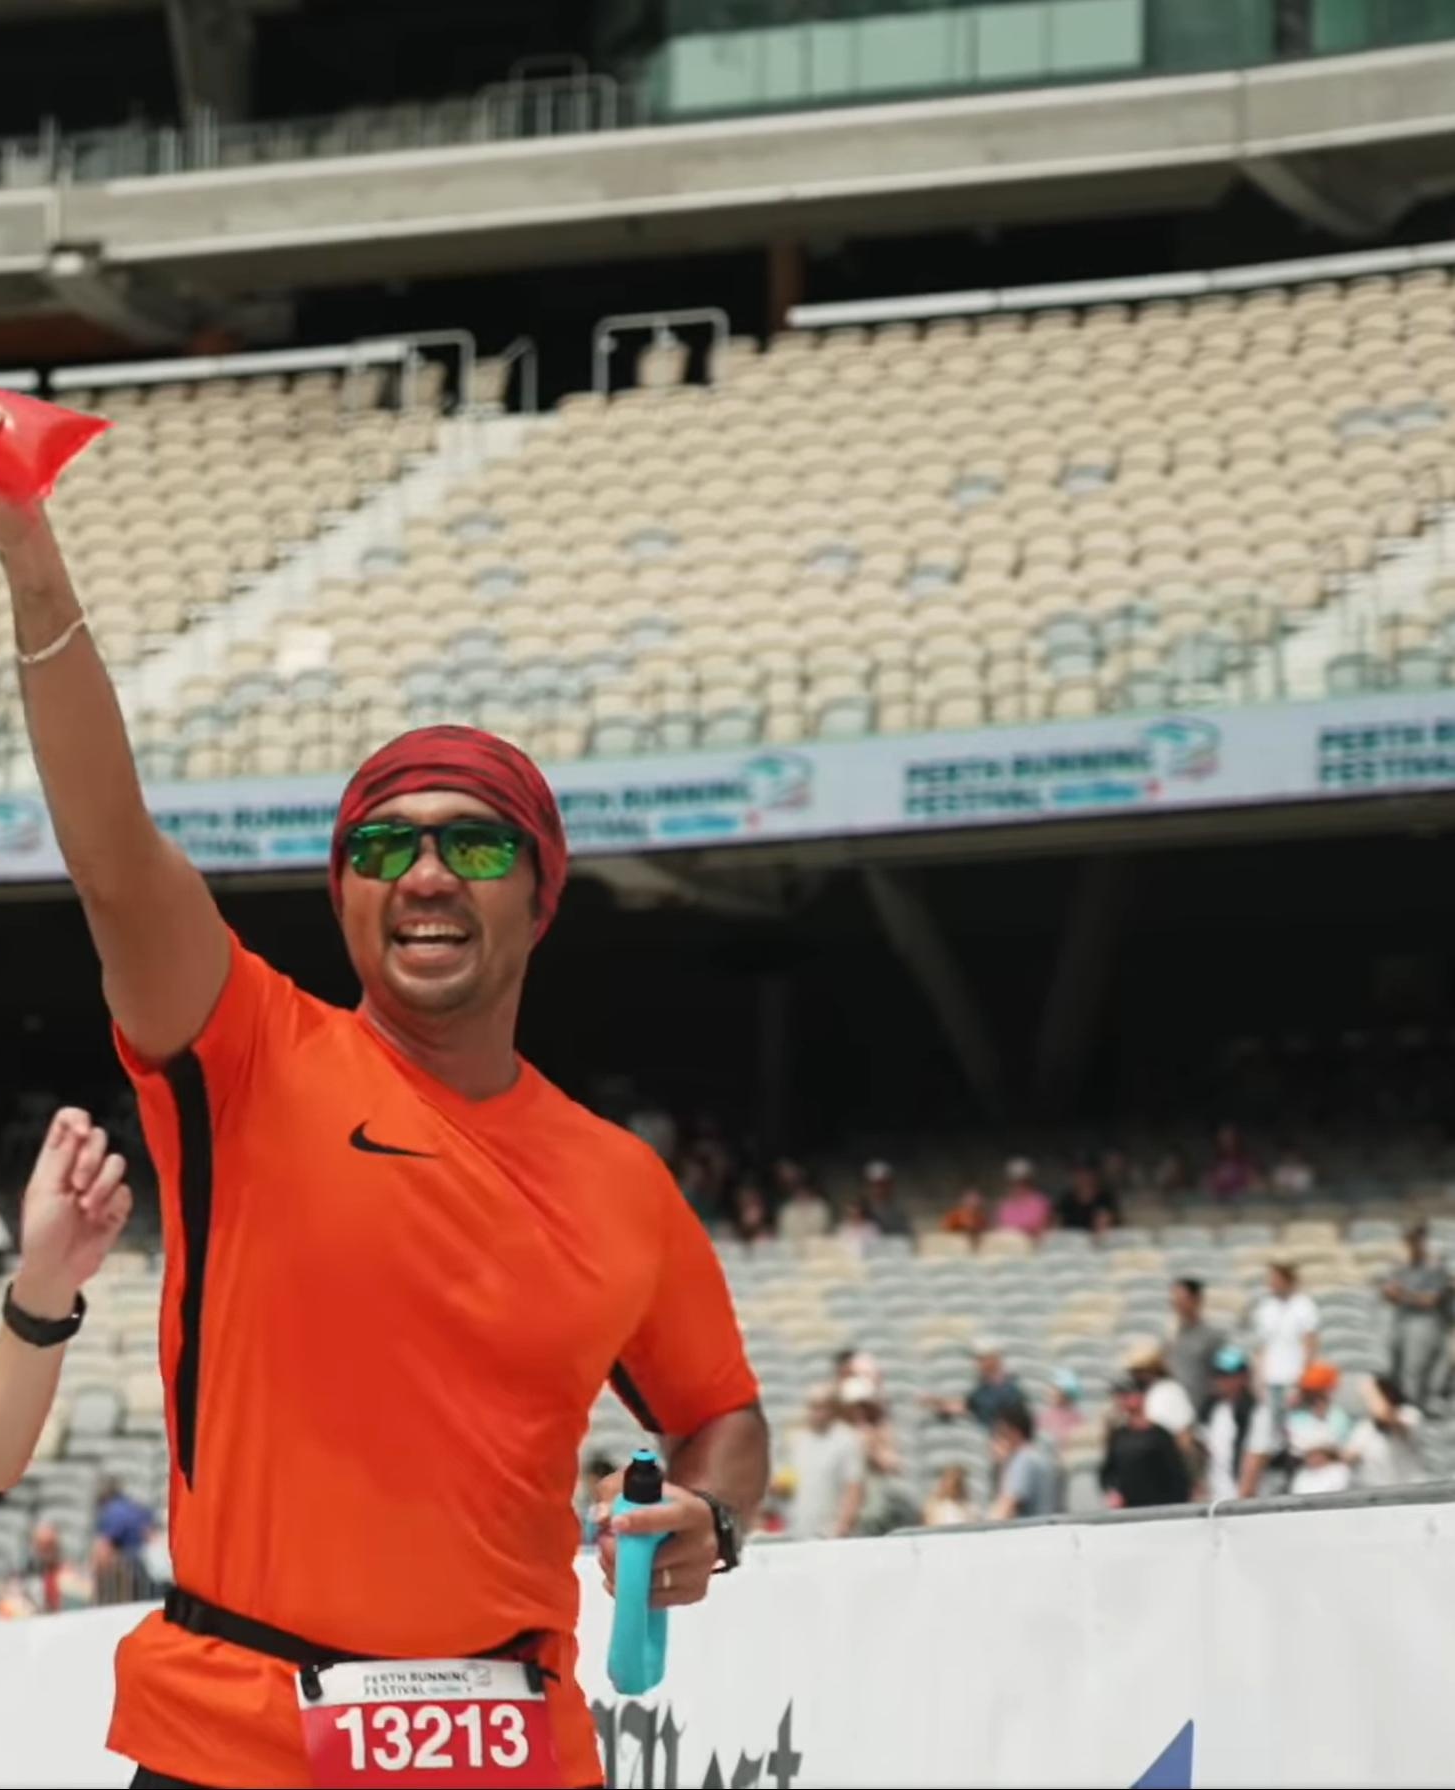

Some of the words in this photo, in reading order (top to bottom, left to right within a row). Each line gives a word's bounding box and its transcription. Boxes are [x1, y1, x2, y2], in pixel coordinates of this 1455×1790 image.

[363, 1672, 407, 1685] PERTH
[363, 1684, 426, 1697] FESTIVAL
[335, 1703, 530, 1772] 13213
